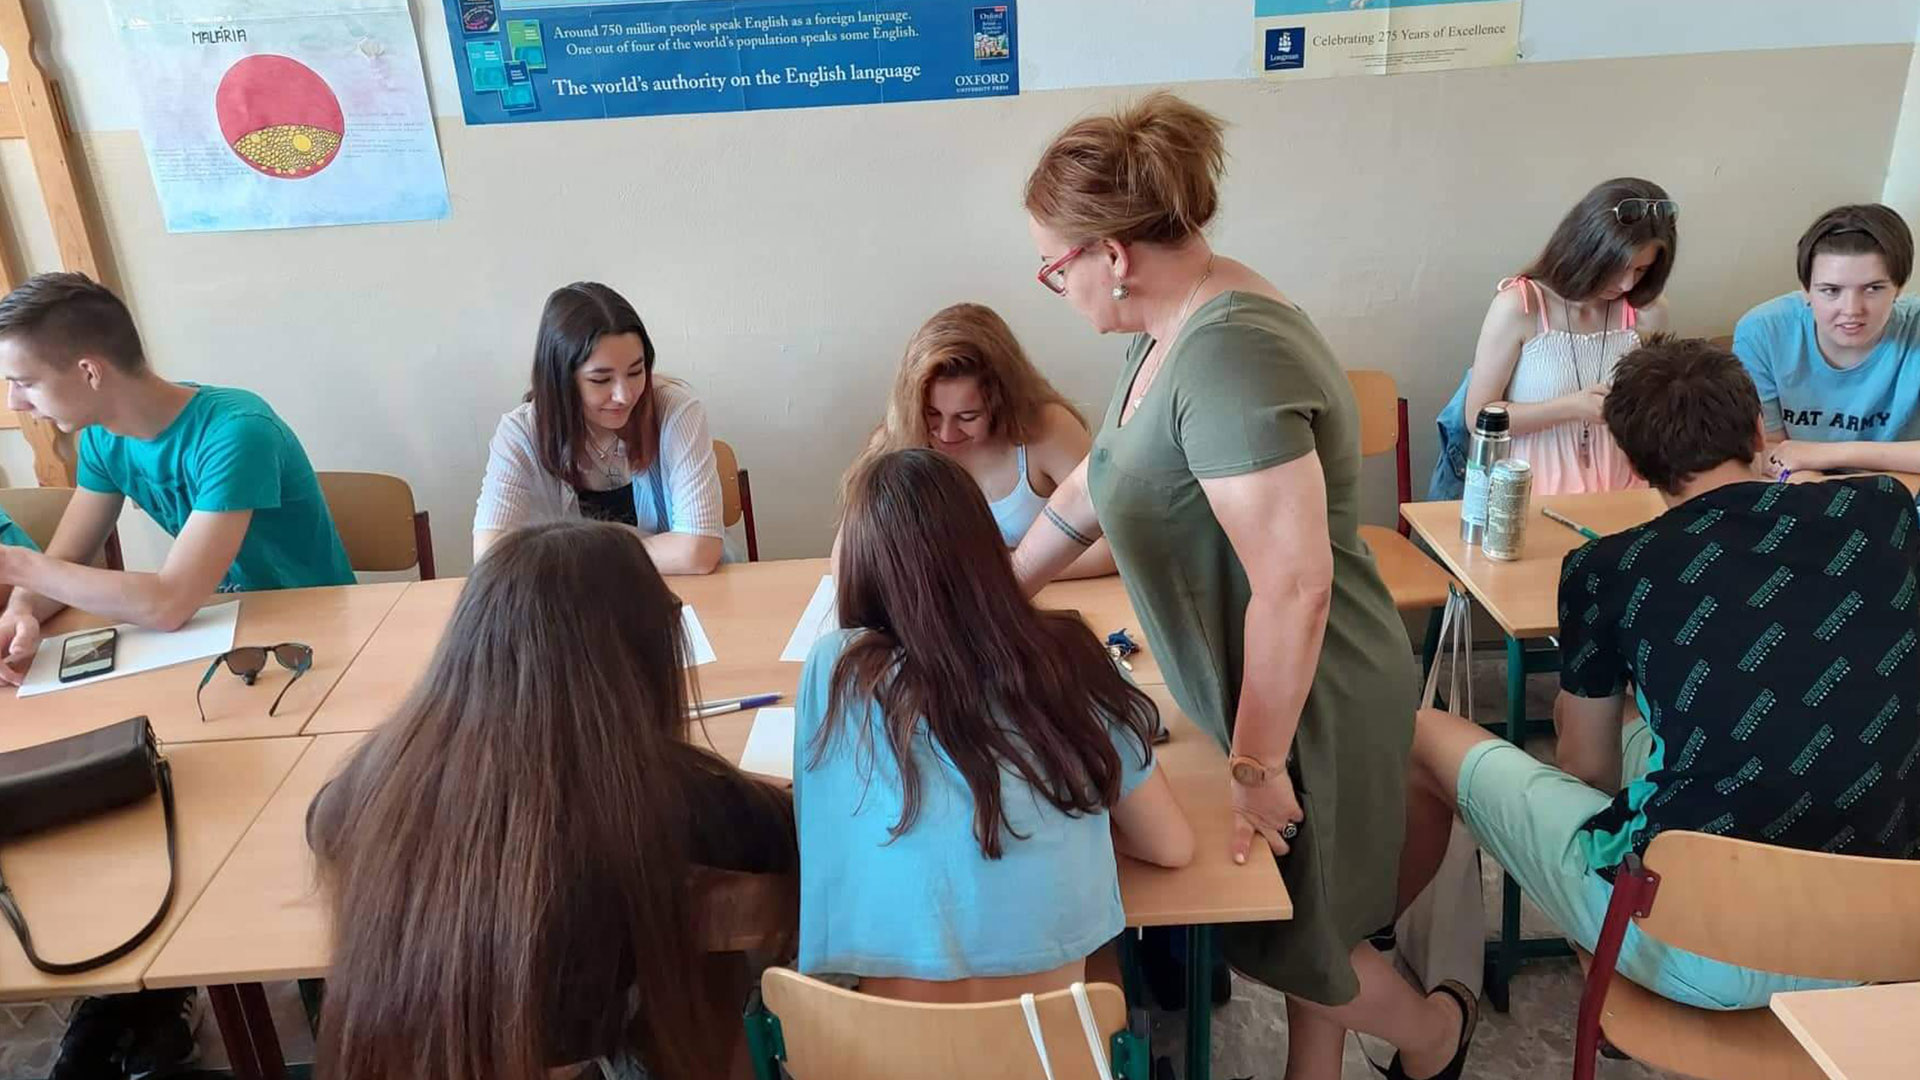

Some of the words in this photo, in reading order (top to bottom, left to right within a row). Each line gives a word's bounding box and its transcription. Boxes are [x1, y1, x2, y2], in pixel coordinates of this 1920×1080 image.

[191, 25, 247, 45] MALÁRIA
[554, 25, 599, 39] Around
[601, 25, 623, 36] 750
[625, 22, 666, 35] million
[670, 20, 707, 35] people
[710, 18, 742, 34] speak
[745, 15, 789, 32] English
[791, 17, 803, 27] as
[805, 17, 812, 26] a
[814, 12, 855, 28] foreign
[858, 10, 912, 25] language.
[1312, 32, 1375, 48] Celebrating
[1377, 30, 1398, 42] 275
[1401, 29, 1430, 41] Years
[1433, 25, 1447, 38] of
[1448, 23, 1506, 38] Excellence
[566, 43, 592, 56] One
[595, 43, 615, 55] out
[617, 41, 631, 53] of
[632, 40, 656, 53] four
[658, 39, 671, 51] of
[672, 38, 692, 50] the
[693, 36, 735, 49] world’s
[736, 33, 798, 50] population
[800, 31, 837, 47] speaks
[840, 31, 870, 41] some
[873, 26, 919, 41] English.
[1270, 53, 1299, 62] Longman
[552, 78, 589, 96] The
[590, 75, 648, 95] world’s
[653, 72, 726, 96] authority
[730, 74, 751, 88] on
[755, 69, 781, 85] the
[785, 65, 846, 88] English
[850, 63, 922, 85] language
[955, 73, 1010, 87] OXFORD
[1828, 411, 1891, 432] ARMY
